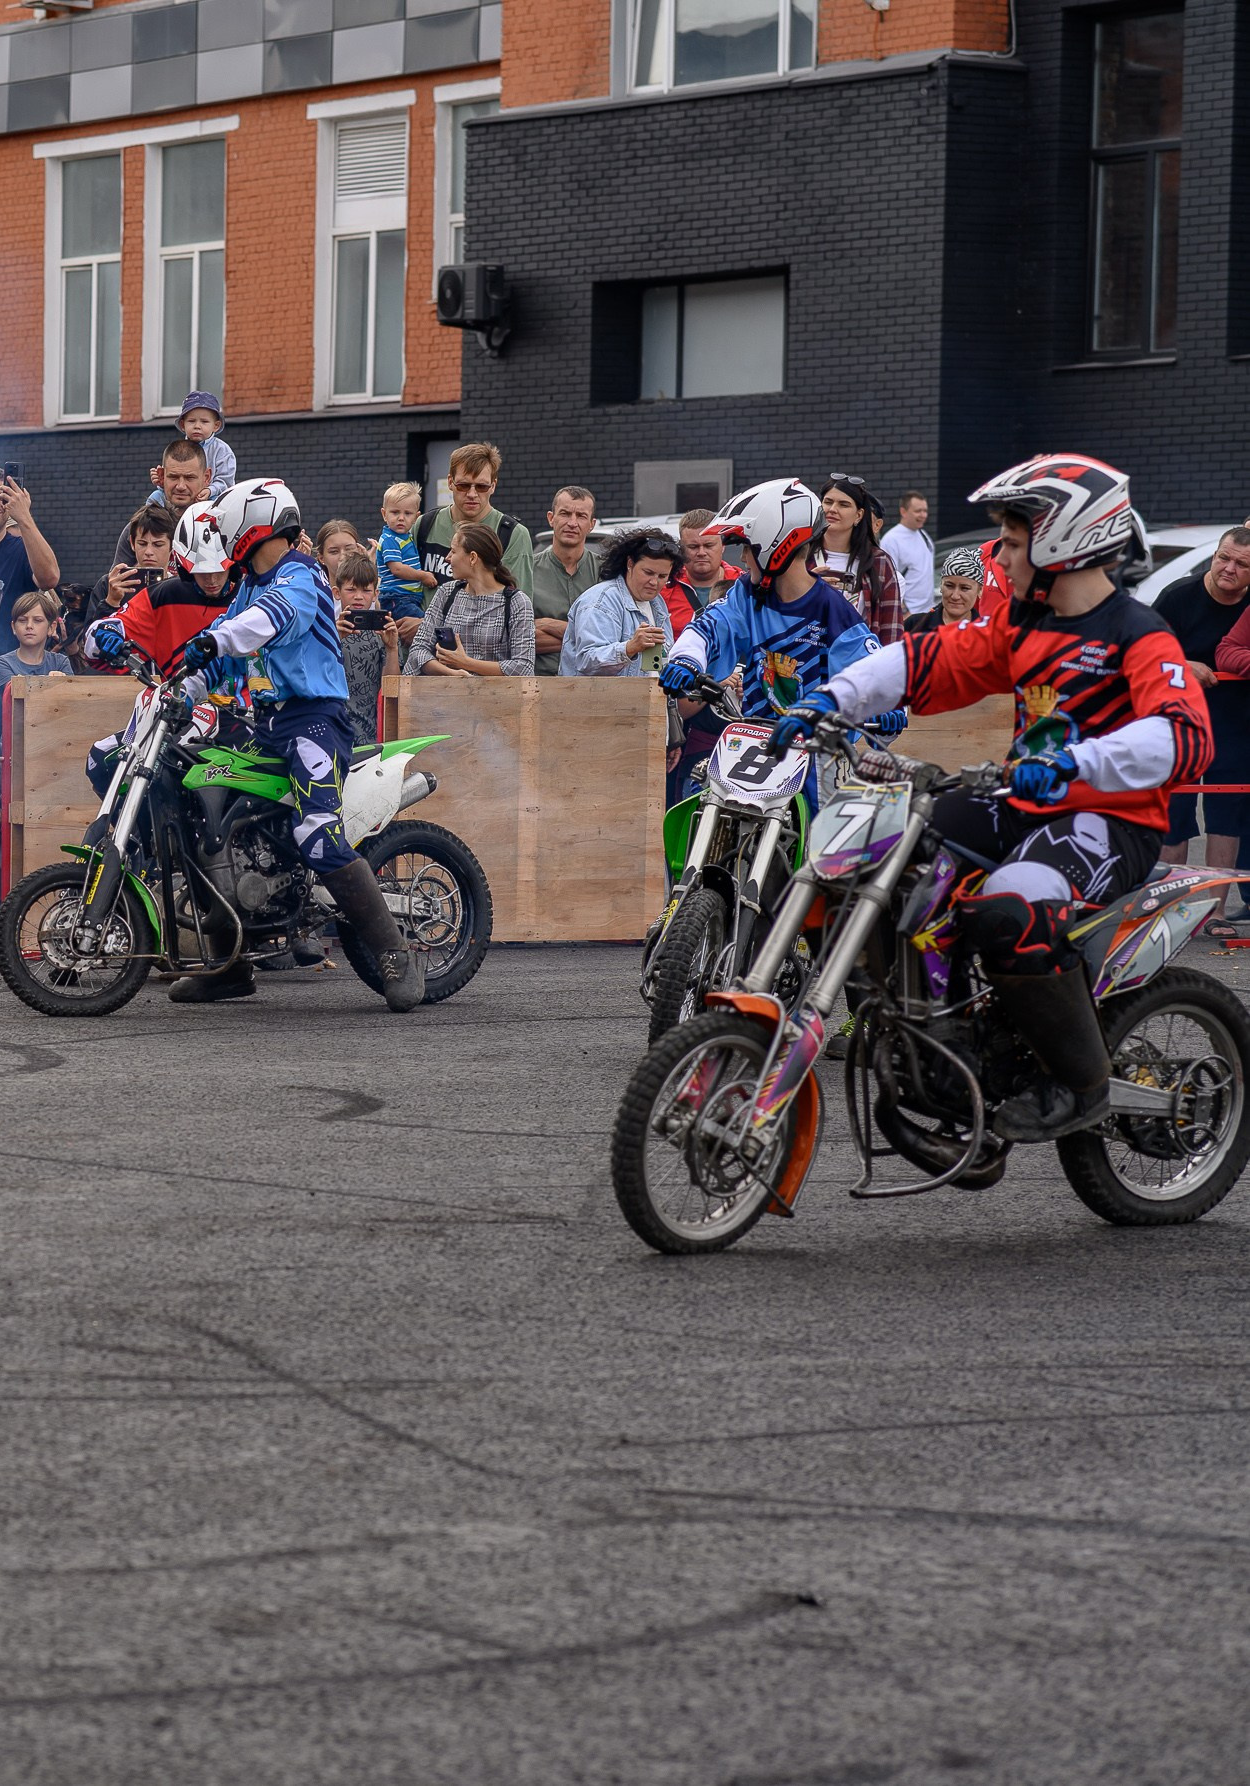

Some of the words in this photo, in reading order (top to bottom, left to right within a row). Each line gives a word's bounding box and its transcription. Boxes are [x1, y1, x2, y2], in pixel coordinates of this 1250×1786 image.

[236, 527, 257, 556] MOTS
[773, 531, 799, 565] MOTS
[424, 552, 454, 577] Nike
[1161, 662, 1186, 689] 7
[192, 708, 211, 721] РЕНА
[727, 745, 781, 785] 8
[821, 802, 877, 856] 7
[1149, 875, 1201, 897] DUNLOP
[1150, 916, 1171, 964] 7
